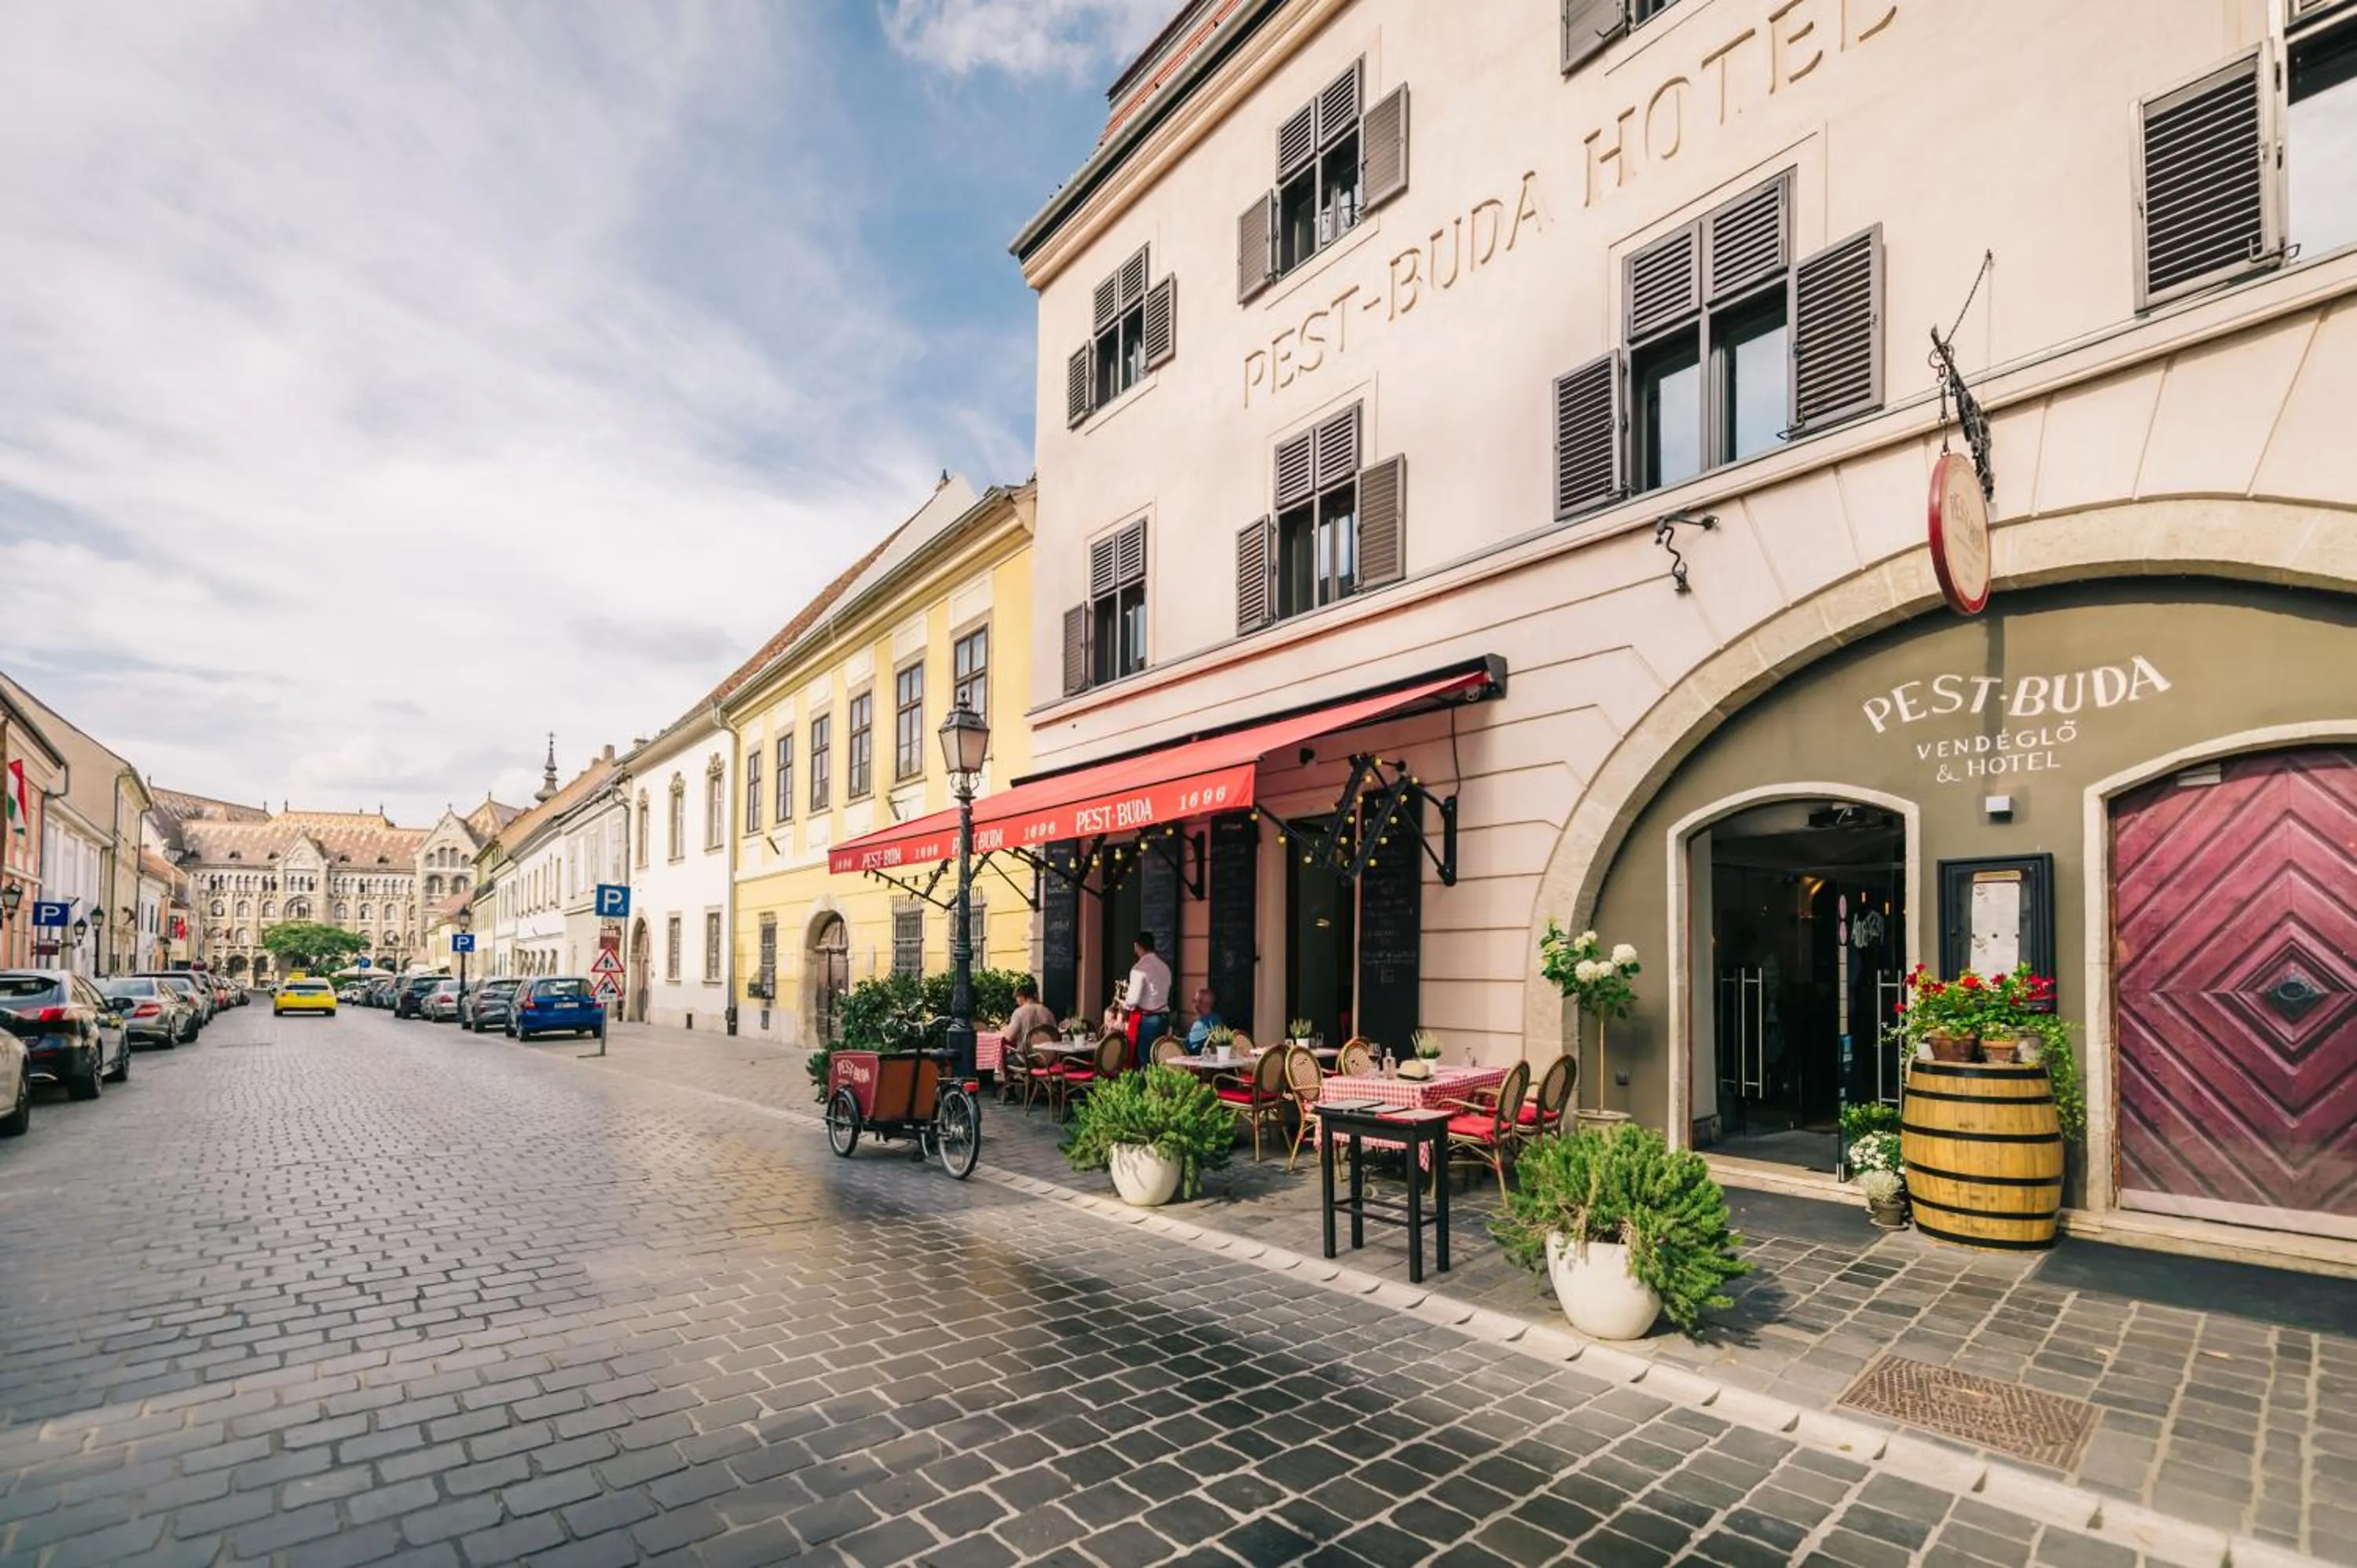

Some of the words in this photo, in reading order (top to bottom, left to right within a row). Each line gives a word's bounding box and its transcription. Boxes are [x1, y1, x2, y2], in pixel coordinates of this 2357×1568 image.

[1244, 170, 1555, 409] PEST-BUDA
[1583, 0, 1898, 208] HOTEL
[1916, 720, 2077, 760] VENDÉGLŐ
[1936, 764, 1962, 784] &
[1967, 752, 2062, 777] HOTEL
[1024, 821, 1056, 841] 1696
[1180, 786, 1226, 811] 1696
[40, 905, 60, 923] P
[603, 888, 622, 913] P
[456, 936, 470, 950] P
